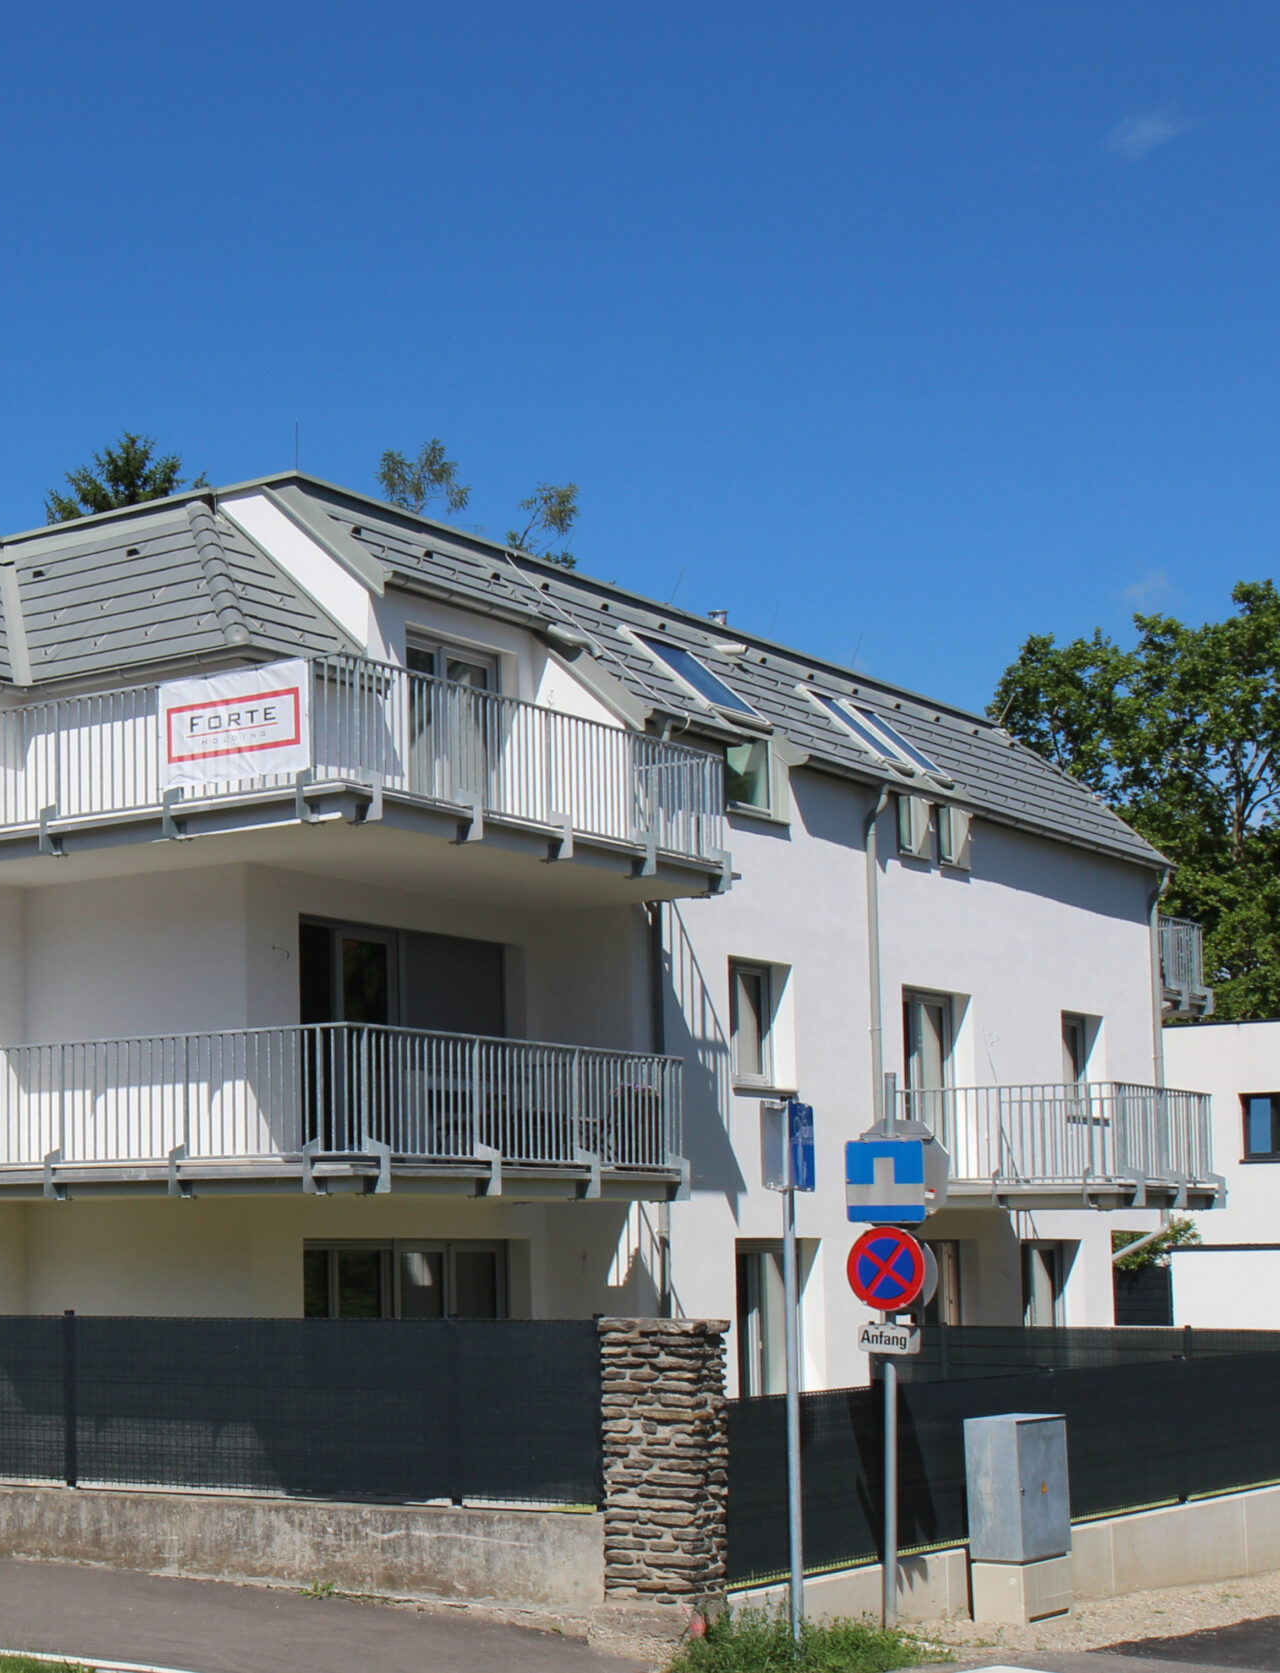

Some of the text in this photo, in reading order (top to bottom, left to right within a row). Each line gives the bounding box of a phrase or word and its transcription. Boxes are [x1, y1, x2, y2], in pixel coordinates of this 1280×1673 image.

[190, 706, 276, 733] FORTE
[201, 730, 266, 745] HOLDING
[861, 1329, 907, 1350] Anfang
